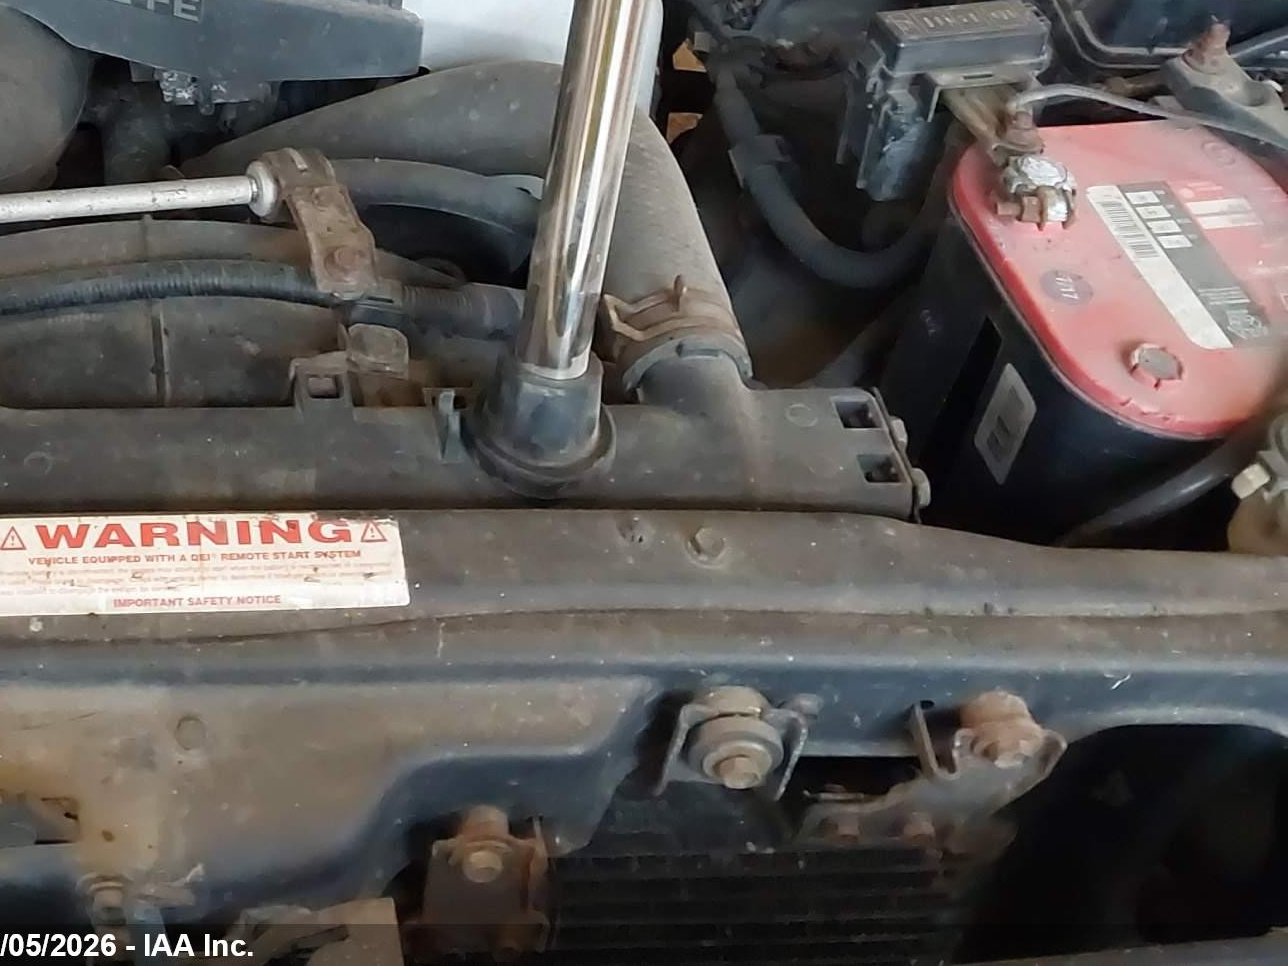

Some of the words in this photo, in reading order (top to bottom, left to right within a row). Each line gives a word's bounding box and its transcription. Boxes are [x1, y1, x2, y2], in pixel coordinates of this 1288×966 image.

[35, 520, 352, 550] WARNING
[28, 556, 78, 565] VEHICLE
[82, 555, 141, 564] EQUIPPED
[145, 554, 176, 563] WITH
[179, 554, 187, 562] A
[220, 552, 270, 561] REMOTE
[273, 551, 310, 560] START
[314, 550, 361, 559] SYSTEM
[113, 598, 183, 608] IMPORTANT
[187, 596, 234, 606] SAFETY
[236, 595, 281, 605] NOTICE
